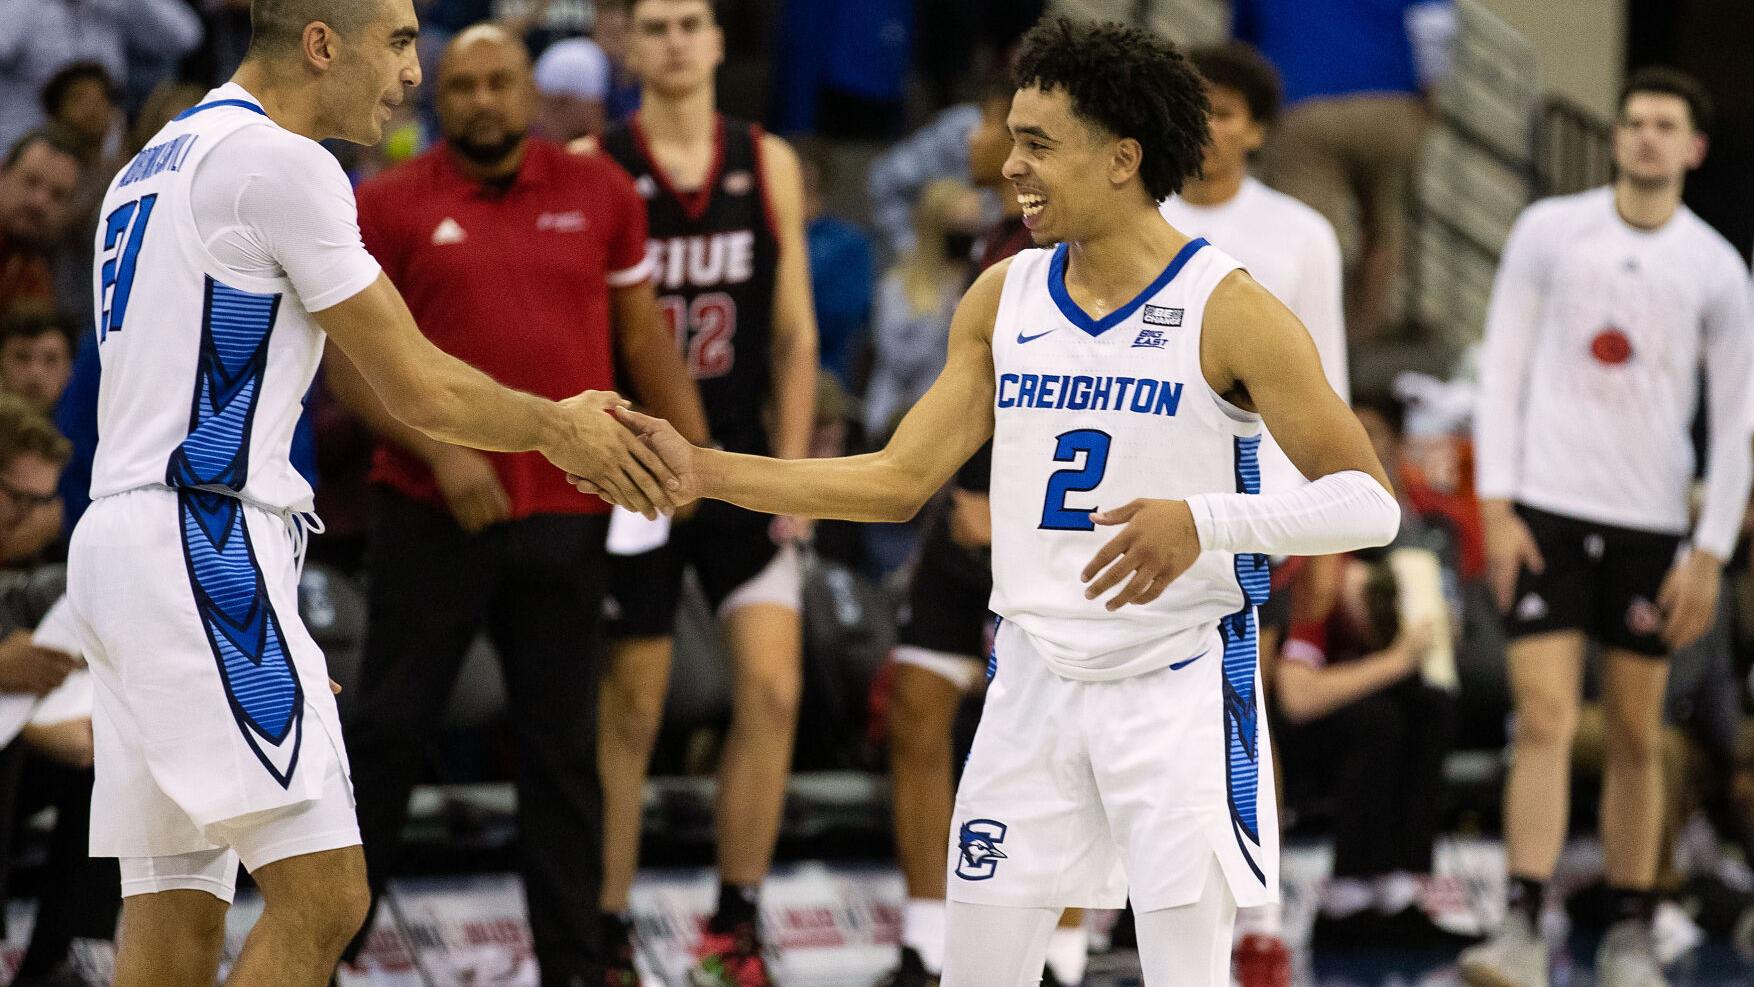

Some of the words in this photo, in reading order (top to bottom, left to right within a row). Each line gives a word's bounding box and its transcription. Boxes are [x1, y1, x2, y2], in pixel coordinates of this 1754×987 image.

[101, 192, 158, 344] 21
[1134, 336, 1168, 346] EAST
[998, 373, 1184, 417] CREIGHTON
[1037, 428, 1112, 531] 2
